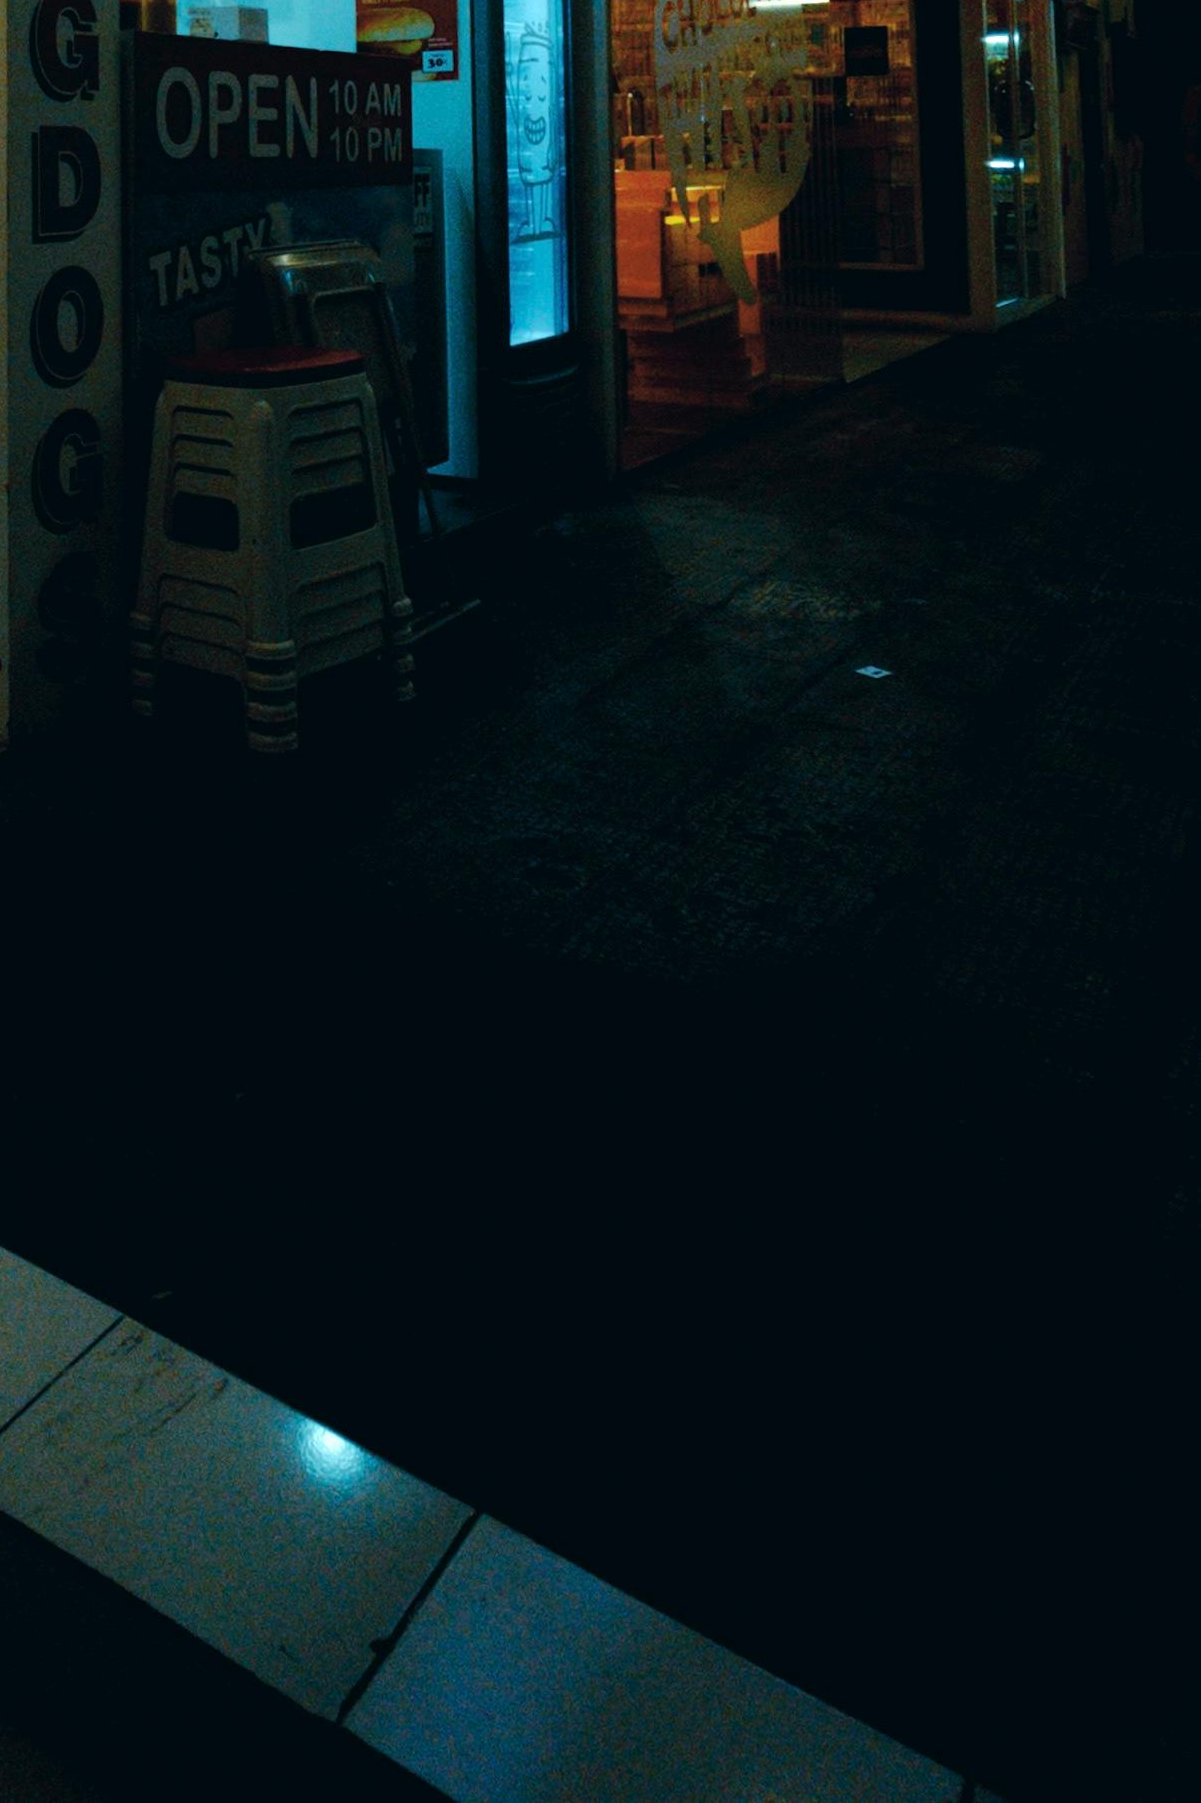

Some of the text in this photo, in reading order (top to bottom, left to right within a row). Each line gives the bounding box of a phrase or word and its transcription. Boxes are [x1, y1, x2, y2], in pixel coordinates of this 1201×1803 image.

[156, 66, 319, 160] OPEN
[328, 79, 402, 118] 10 AM
[328, 126, 403, 163] 10 PM
[148, 217, 270, 308] TASTY
